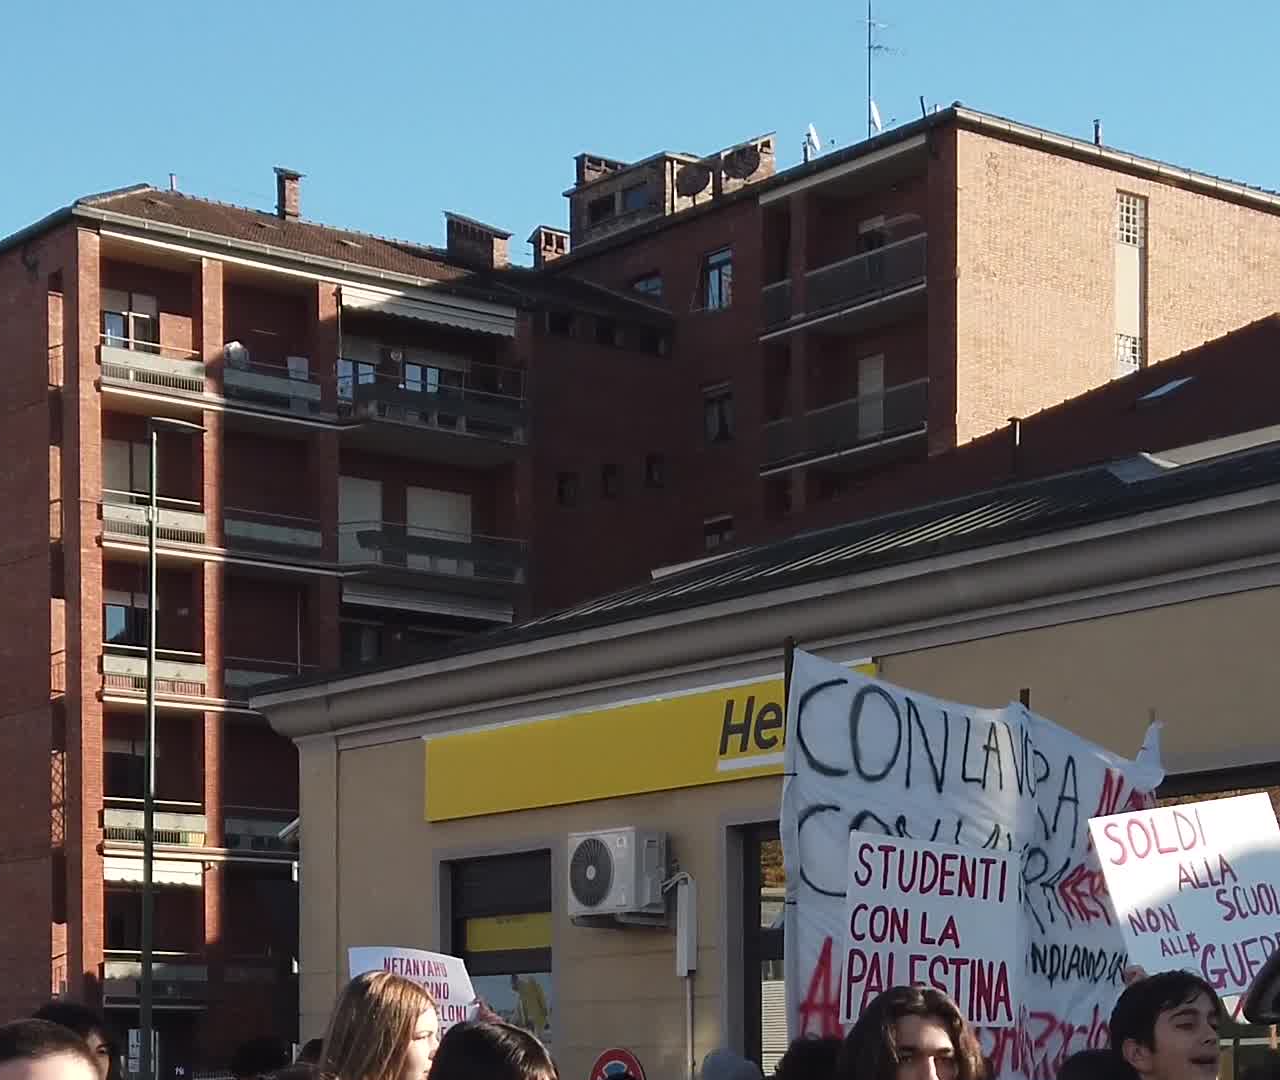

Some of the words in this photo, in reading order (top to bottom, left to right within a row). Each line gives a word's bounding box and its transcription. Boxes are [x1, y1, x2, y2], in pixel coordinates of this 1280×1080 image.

[719, 695, 783, 756] He
[797, 679, 949, 793] CON
[961, 714, 1004, 790] LA
[1103, 807, 1206, 866] SOLDI
[854, 843, 1007, 903] STUDENTI
[1178, 853, 1238, 892] ALLA
[850, 903, 909, 946] CON
[920, 911, 961, 950] LA
[1127, 903, 1181, 937] NON
[383, 956, 448, 978] NETANYAHU
[845, 948, 1014, 1023] PALESTINA
